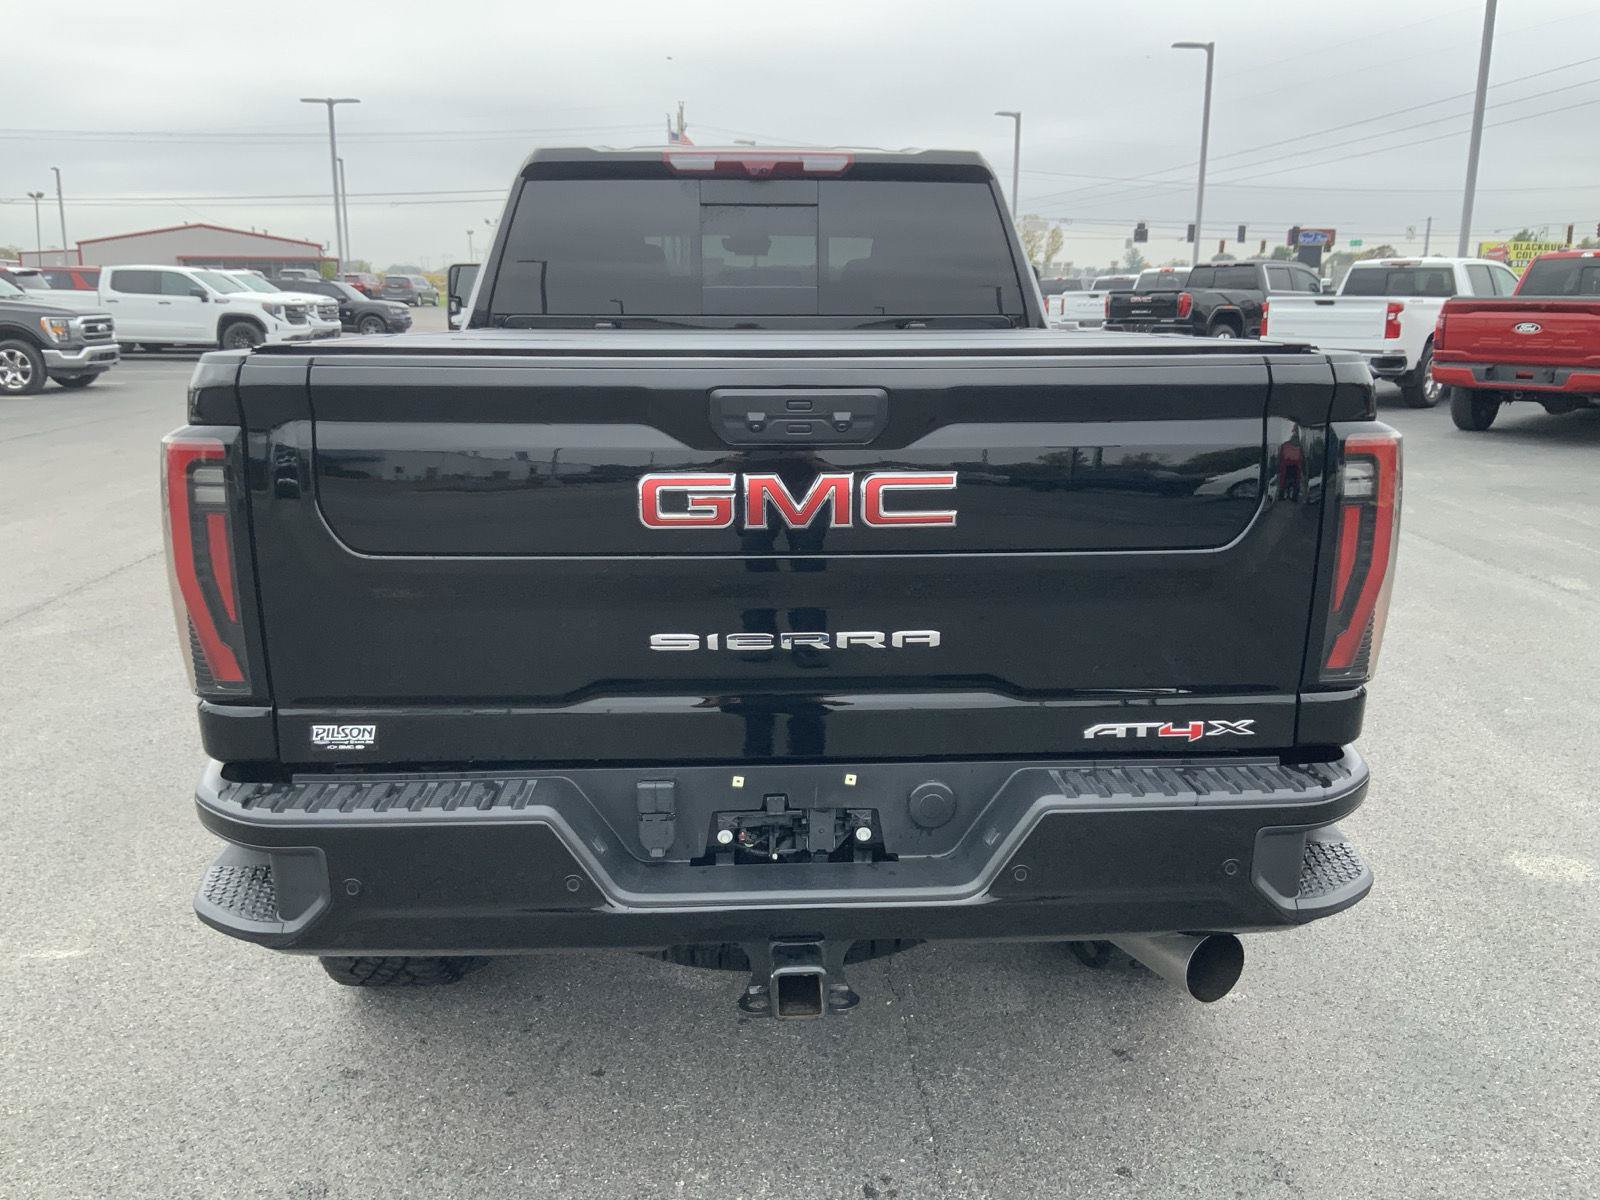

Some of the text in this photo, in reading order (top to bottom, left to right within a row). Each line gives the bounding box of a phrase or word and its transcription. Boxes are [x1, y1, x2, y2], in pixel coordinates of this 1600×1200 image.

[638, 471, 958, 530] GMC
[649, 629, 941, 651] SIERRA
[314, 727, 374, 740] PILSON
[1083, 719, 1256, 743] AT4X
